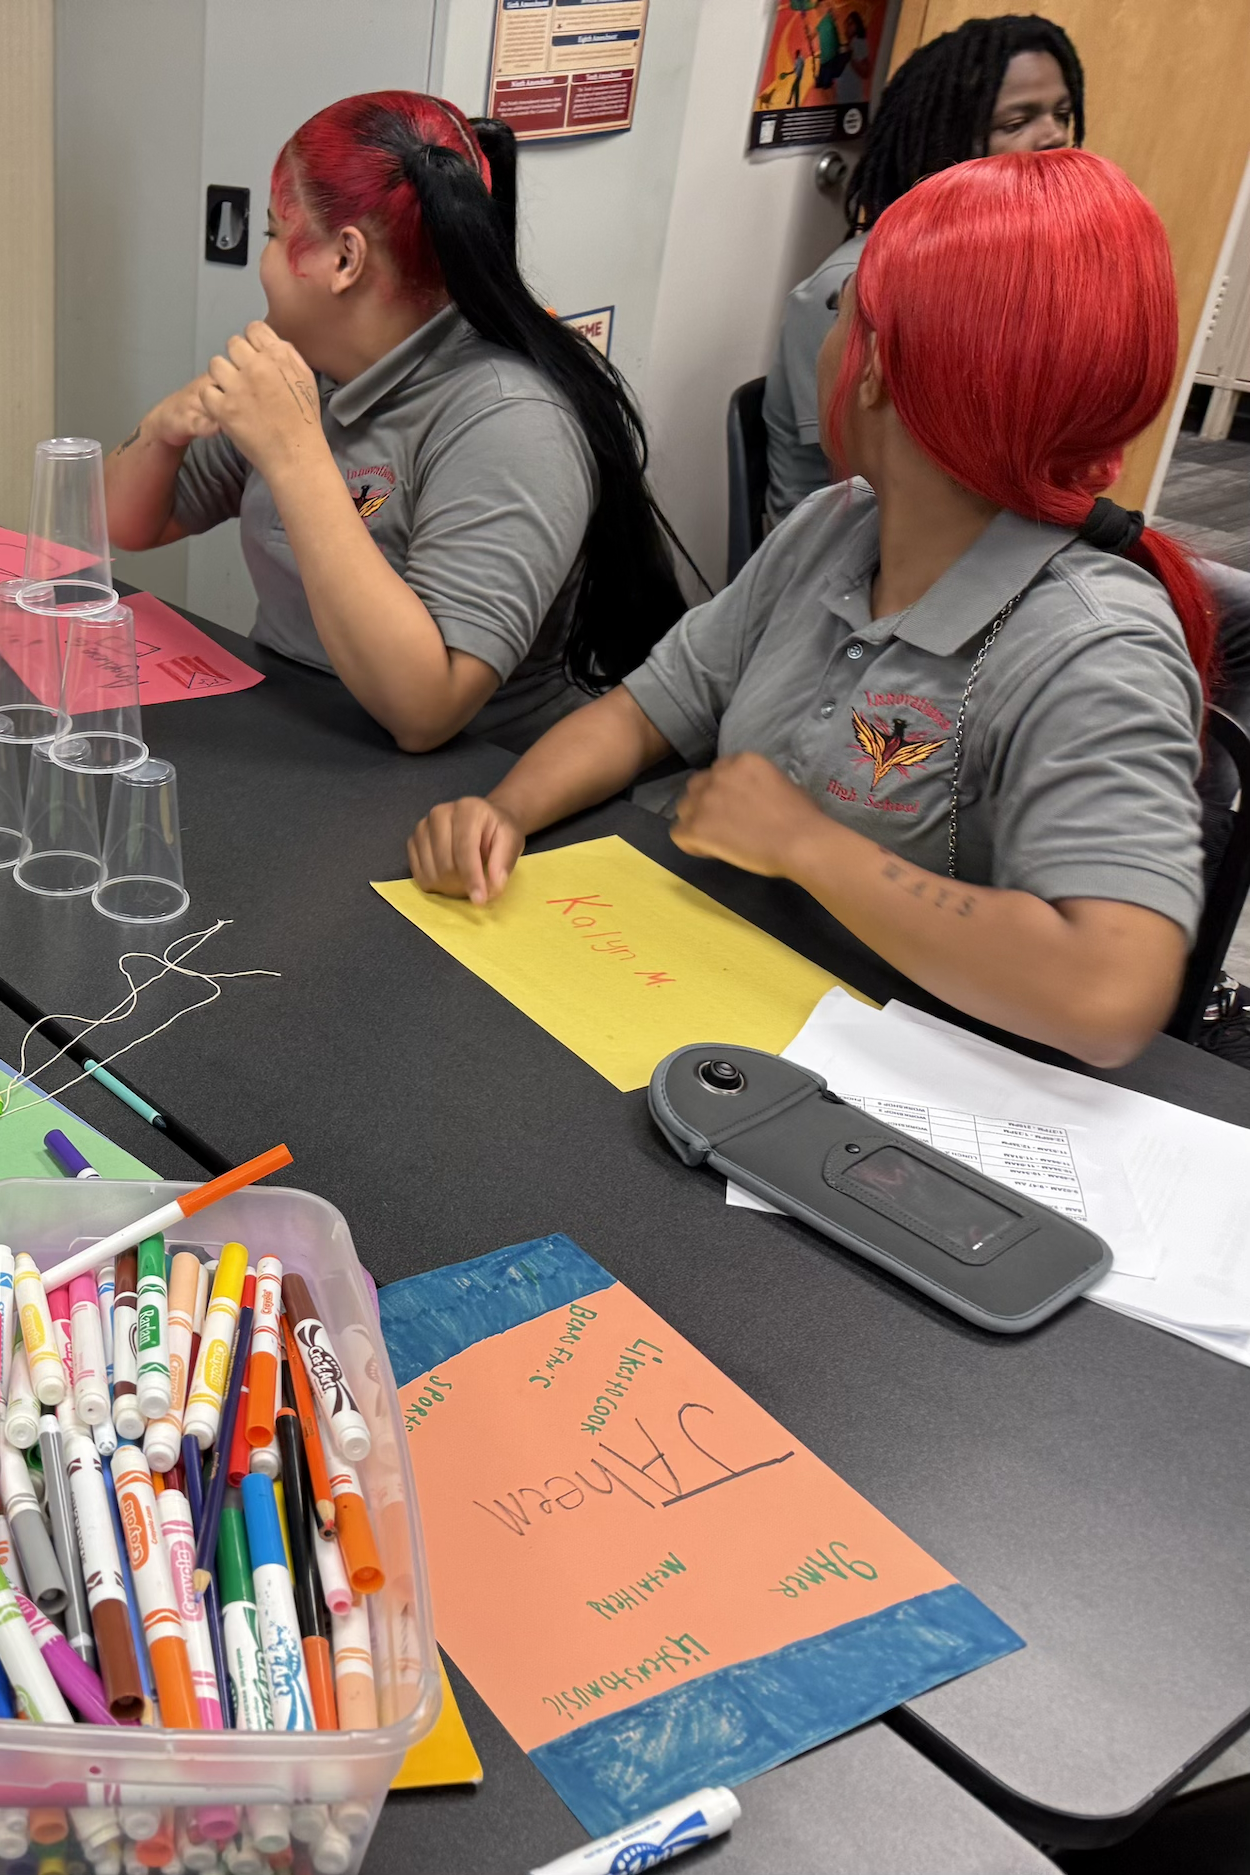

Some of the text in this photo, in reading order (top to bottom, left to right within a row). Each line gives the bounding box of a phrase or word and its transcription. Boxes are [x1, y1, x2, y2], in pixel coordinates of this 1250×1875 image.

[826, 778, 921, 815] High School
[261, 1290, 273, 1315] Crayola
[210, 1343, 226, 1387] Crayola
[122, 1499, 146, 1566] Crayola
